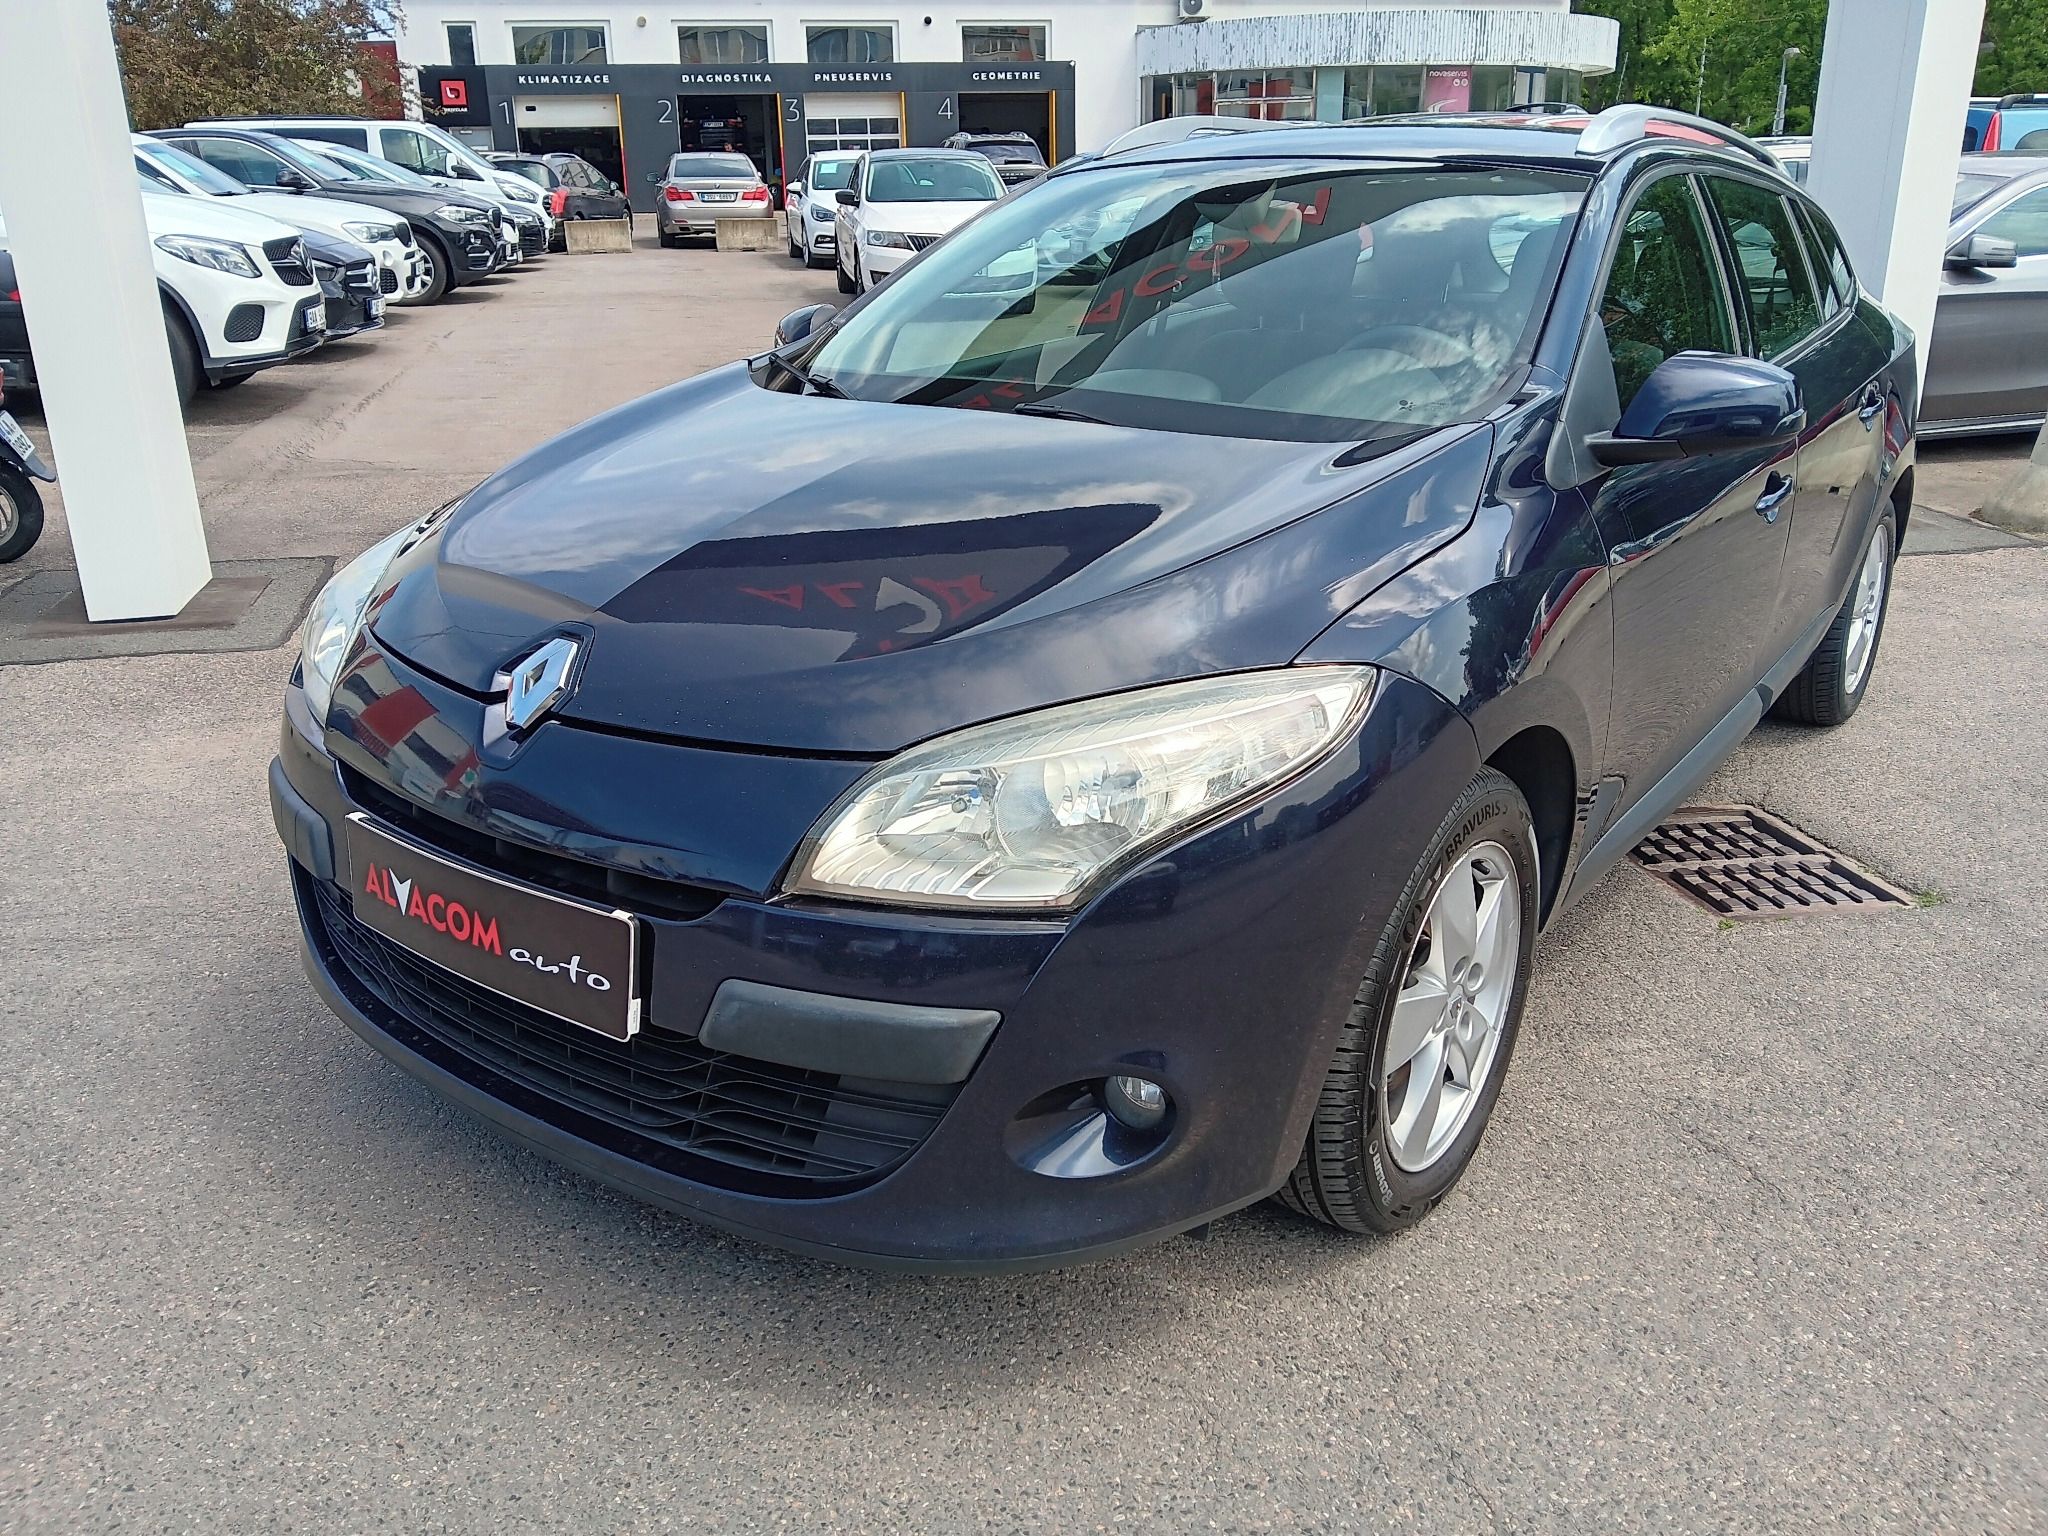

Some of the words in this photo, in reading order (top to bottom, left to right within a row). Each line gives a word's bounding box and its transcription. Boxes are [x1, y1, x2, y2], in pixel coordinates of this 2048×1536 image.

[518, 74, 611, 84] KLIMATIZACE
[681, 73, 772, 83] DIAGNOSTIKA
[814, 72, 893, 82] PNEUSERVIS
[972, 71, 1041, 81] GEOMETRIE
[498, 101, 510, 124] 1
[657, 99, 673, 123] 2
[785, 98, 800, 122] 3
[937, 97, 953, 120] 4
[1445, 800, 1501, 862] BRAVURIS
[364, 862, 502, 956] ALVACOM
[508, 948, 611, 991] auto
